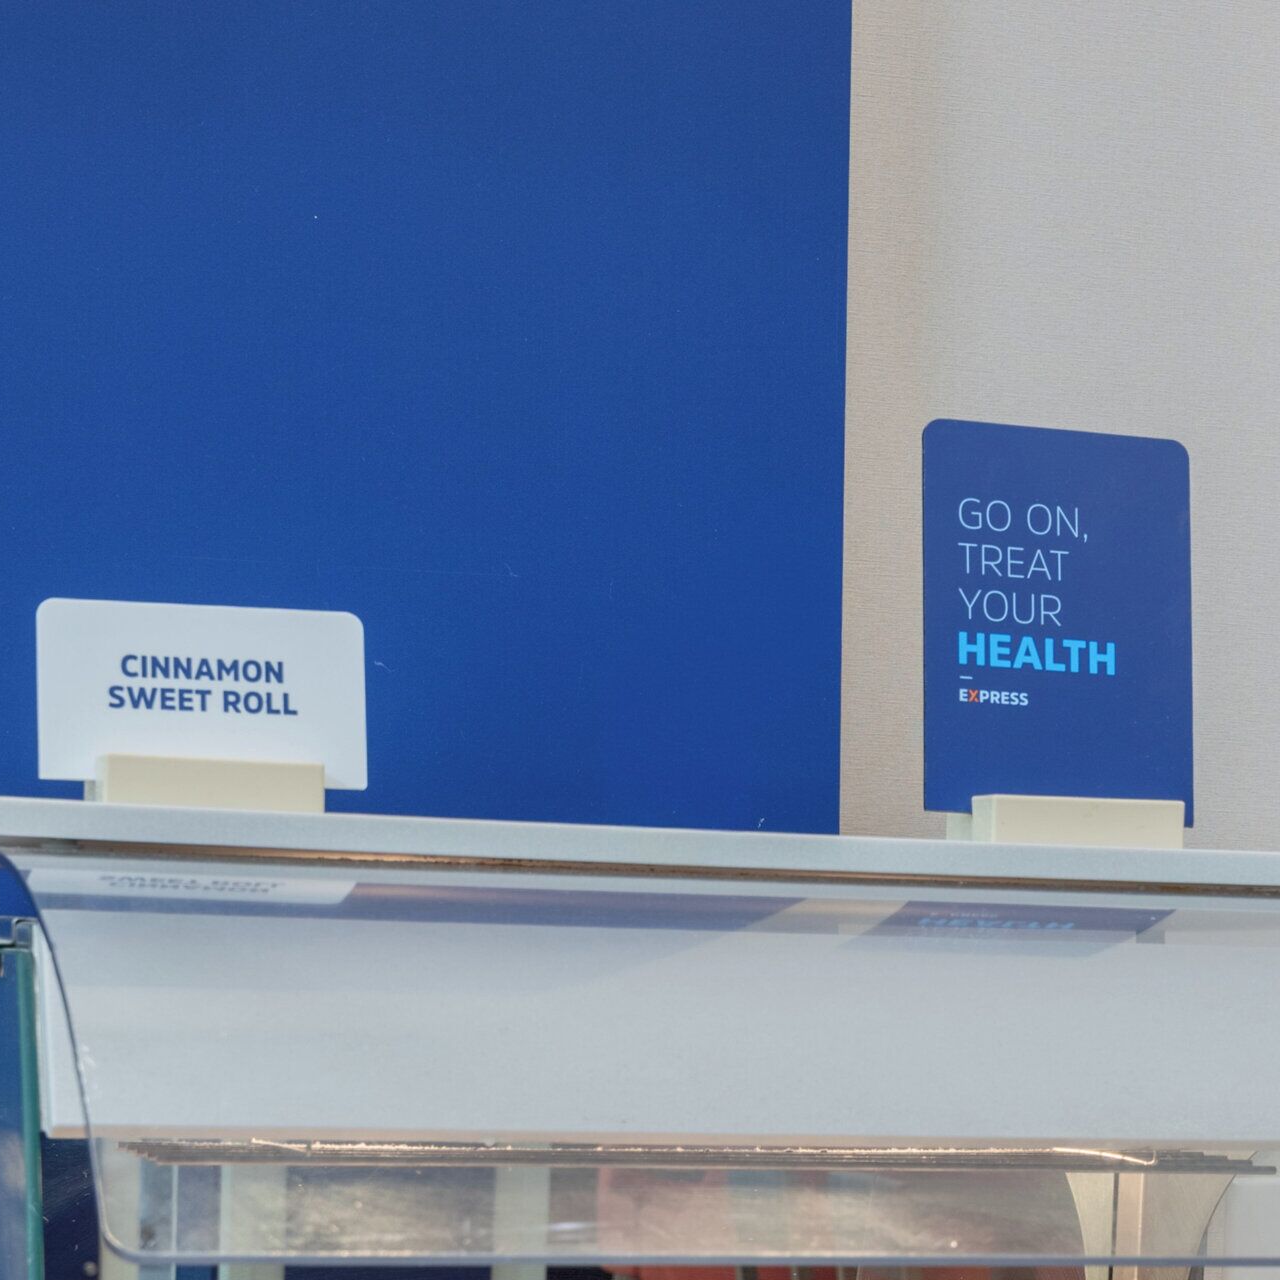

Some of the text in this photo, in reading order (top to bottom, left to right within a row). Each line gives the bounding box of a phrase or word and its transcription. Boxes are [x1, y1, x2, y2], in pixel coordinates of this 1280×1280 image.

[957, 497, 1088, 543] GO ON,
[957, 542, 1070, 581] TREAT
[957, 587, 1062, 627] YOUR
[120, 654, 285, 684] CINNAMON
[957, 631, 1116, 676] HEALTH
[107, 685, 299, 716] SWEET ROLL
[958, 688, 1029, 707] EXPRESS
